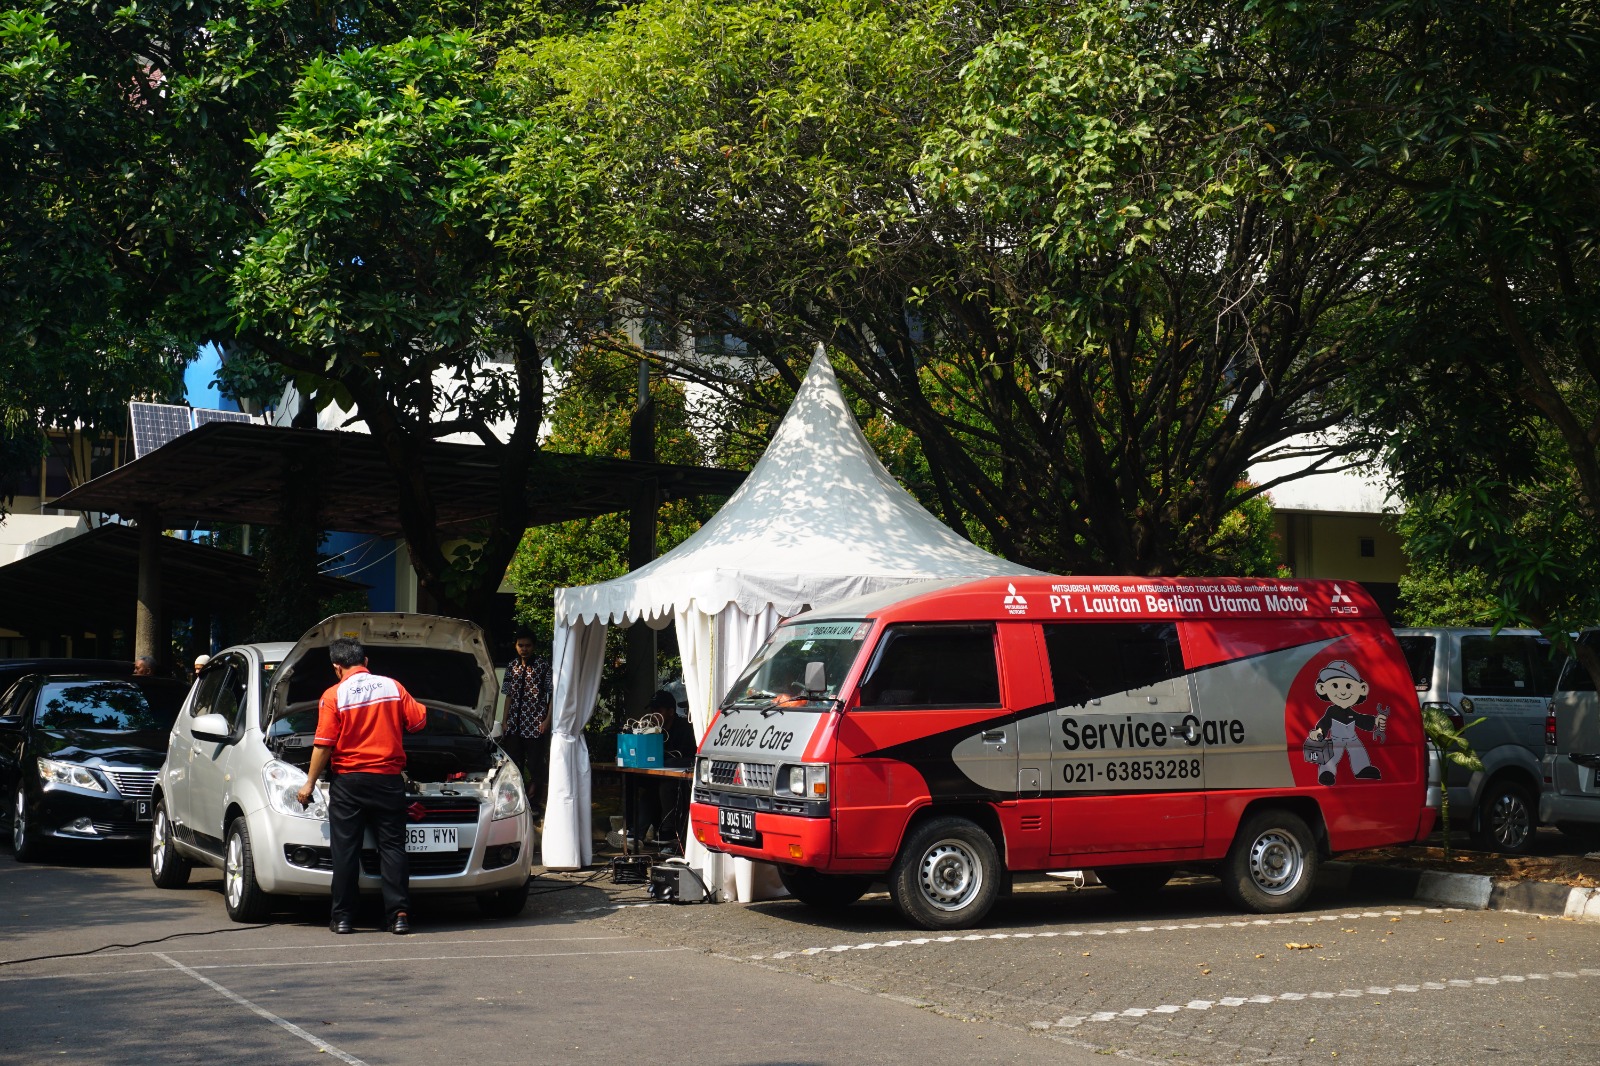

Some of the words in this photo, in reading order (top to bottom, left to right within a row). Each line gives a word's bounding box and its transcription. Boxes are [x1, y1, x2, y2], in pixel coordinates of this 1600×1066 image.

[1176, 585, 1194, 593] FUSO
[1195, 585, 1219, 593] TRUCK
[1221, 585, 1227, 593] &
[1050, 595, 1077, 613] PT.
[1083, 595, 1141, 613] Lautan
[1145, 595, 1204, 613] Berlian
[1207, 595, 1261, 612] Utama
[1265, 595, 1309, 612] Motor
[1330, 606, 1359, 614] FUSO
[808, 626, 837, 636] EMBATAN
[837, 626, 854, 635] LIMA
[350, 682, 383, 695] Service
[714, 723, 758, 747] Service
[759, 725, 793, 751] Care
[1062, 715, 1167, 750] Service
[1182, 715, 1245, 746] Care
[1063, 759, 1200, 783] 021-63853288
[140, 803, 146, 814] B
[721, 811, 725, 825] B
[726, 812, 740, 828] 9045
[741, 814, 752, 829] TCH
[433, 829, 456, 843] WYN
